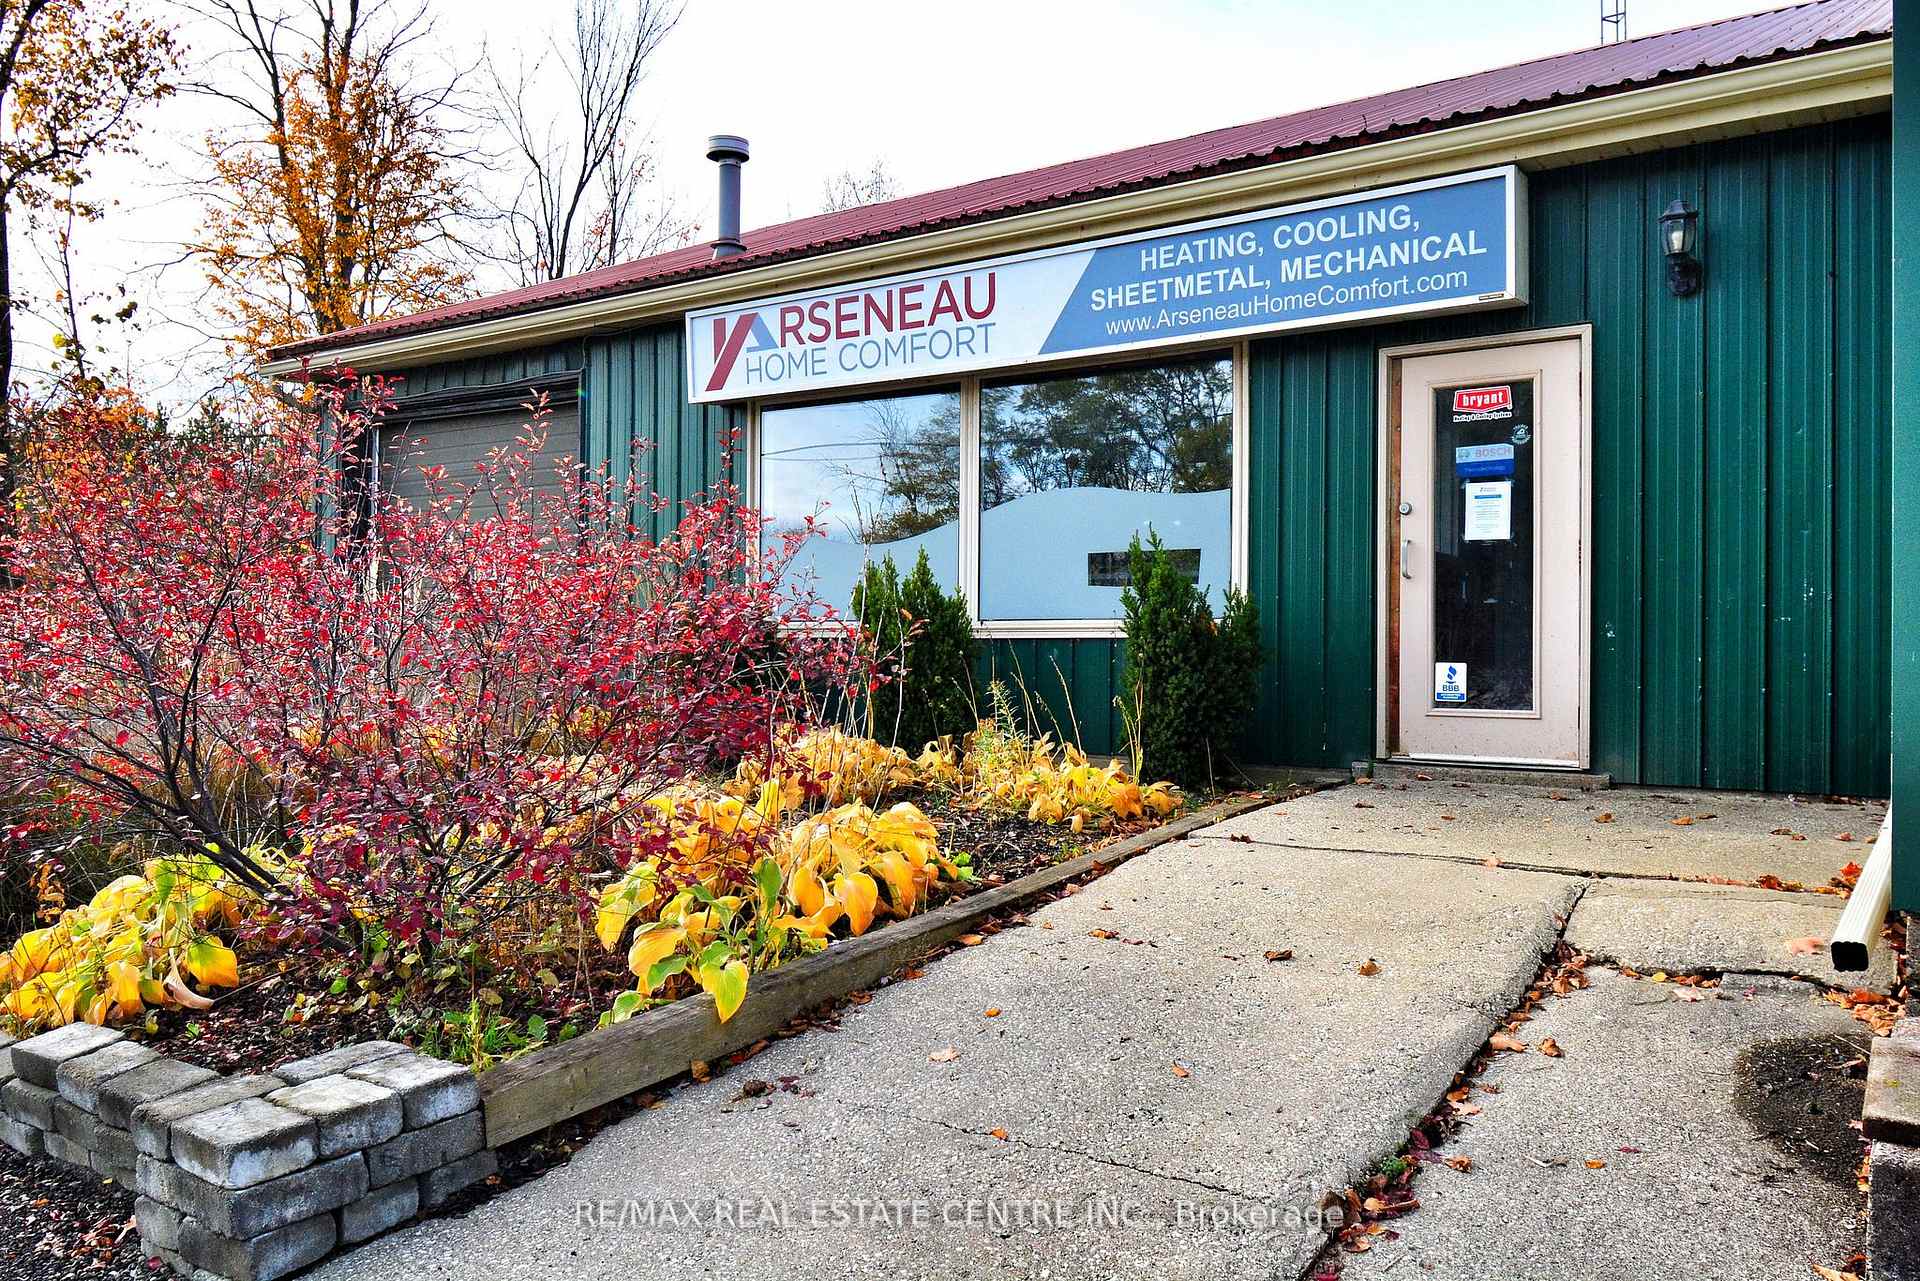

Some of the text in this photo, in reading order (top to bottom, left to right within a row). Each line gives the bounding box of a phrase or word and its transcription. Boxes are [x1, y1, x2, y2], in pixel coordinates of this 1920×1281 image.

[1140, 204, 1420, 272] HEATING, COOLING,
[1090, 230, 1488, 312] SHEETMETAL, MECHANICAL
[1105, 268, 1468, 335] www.ArseneauHomeComfort.com
[745, 322, 996, 385] HOME COMFORT
[1462, 391, 1504, 407] bryant
[1475, 446, 1510, 458] BOSCH
[1442, 684, 1460, 692] BBB
